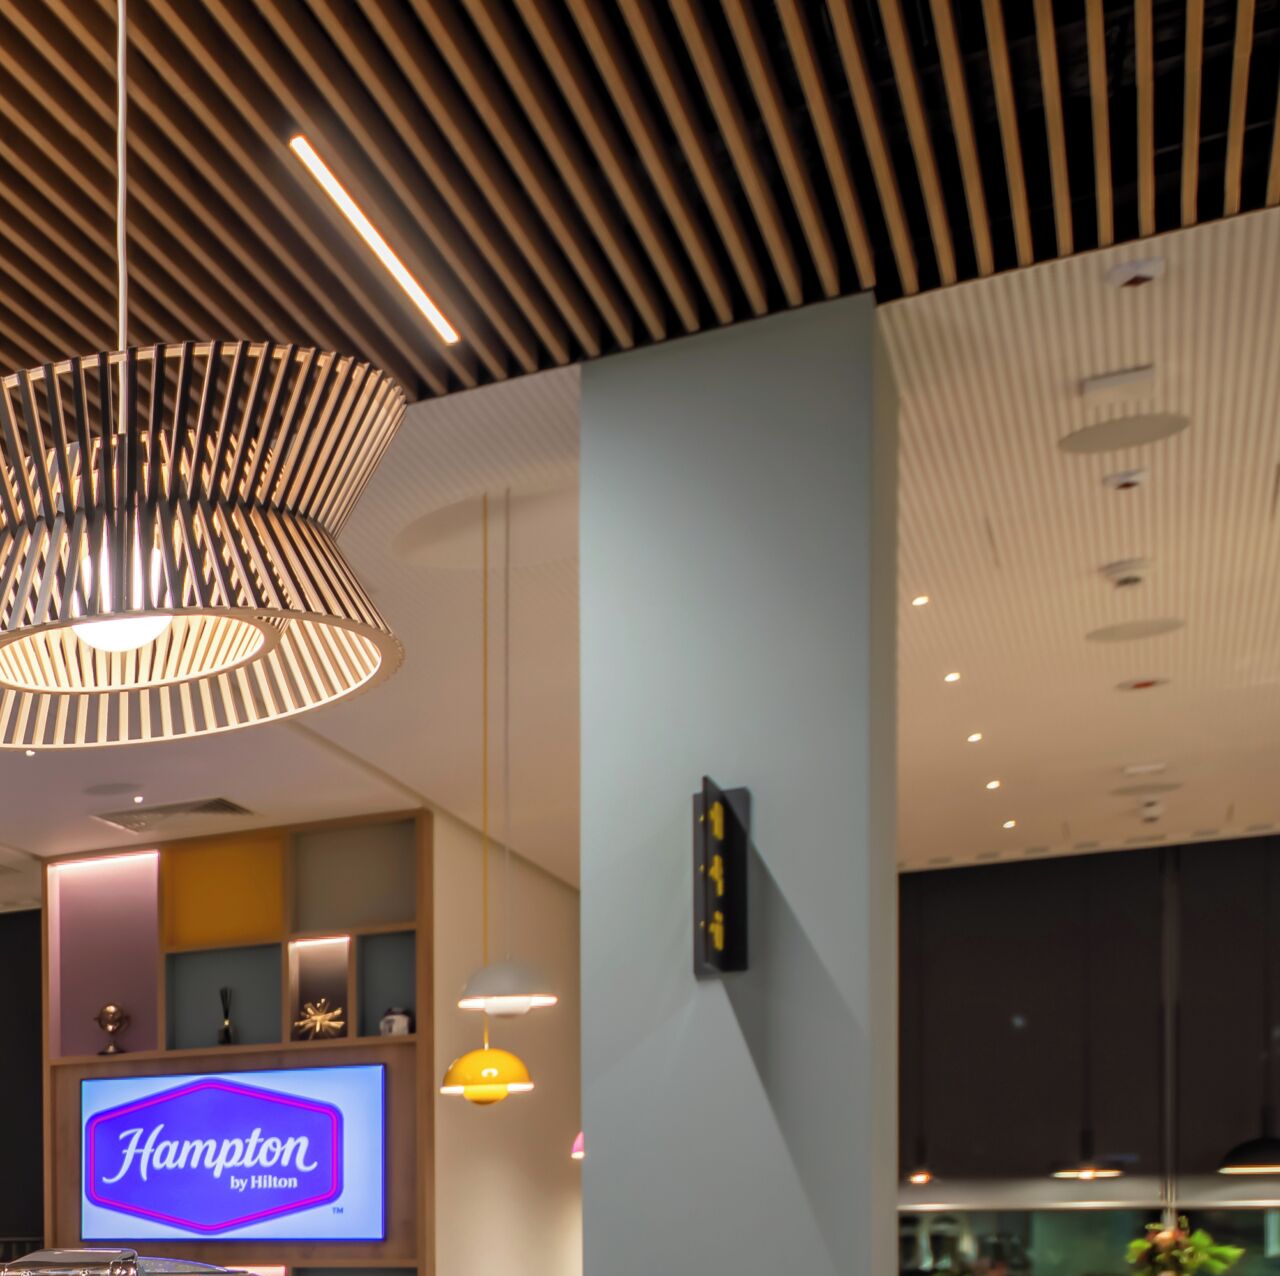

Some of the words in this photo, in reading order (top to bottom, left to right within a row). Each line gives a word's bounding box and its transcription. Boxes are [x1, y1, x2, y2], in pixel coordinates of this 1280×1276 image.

[102, 1123, 318, 1184] Hampton
[230, 1175, 248, 1192] by
[251, 1174, 298, 1189] Hilton
